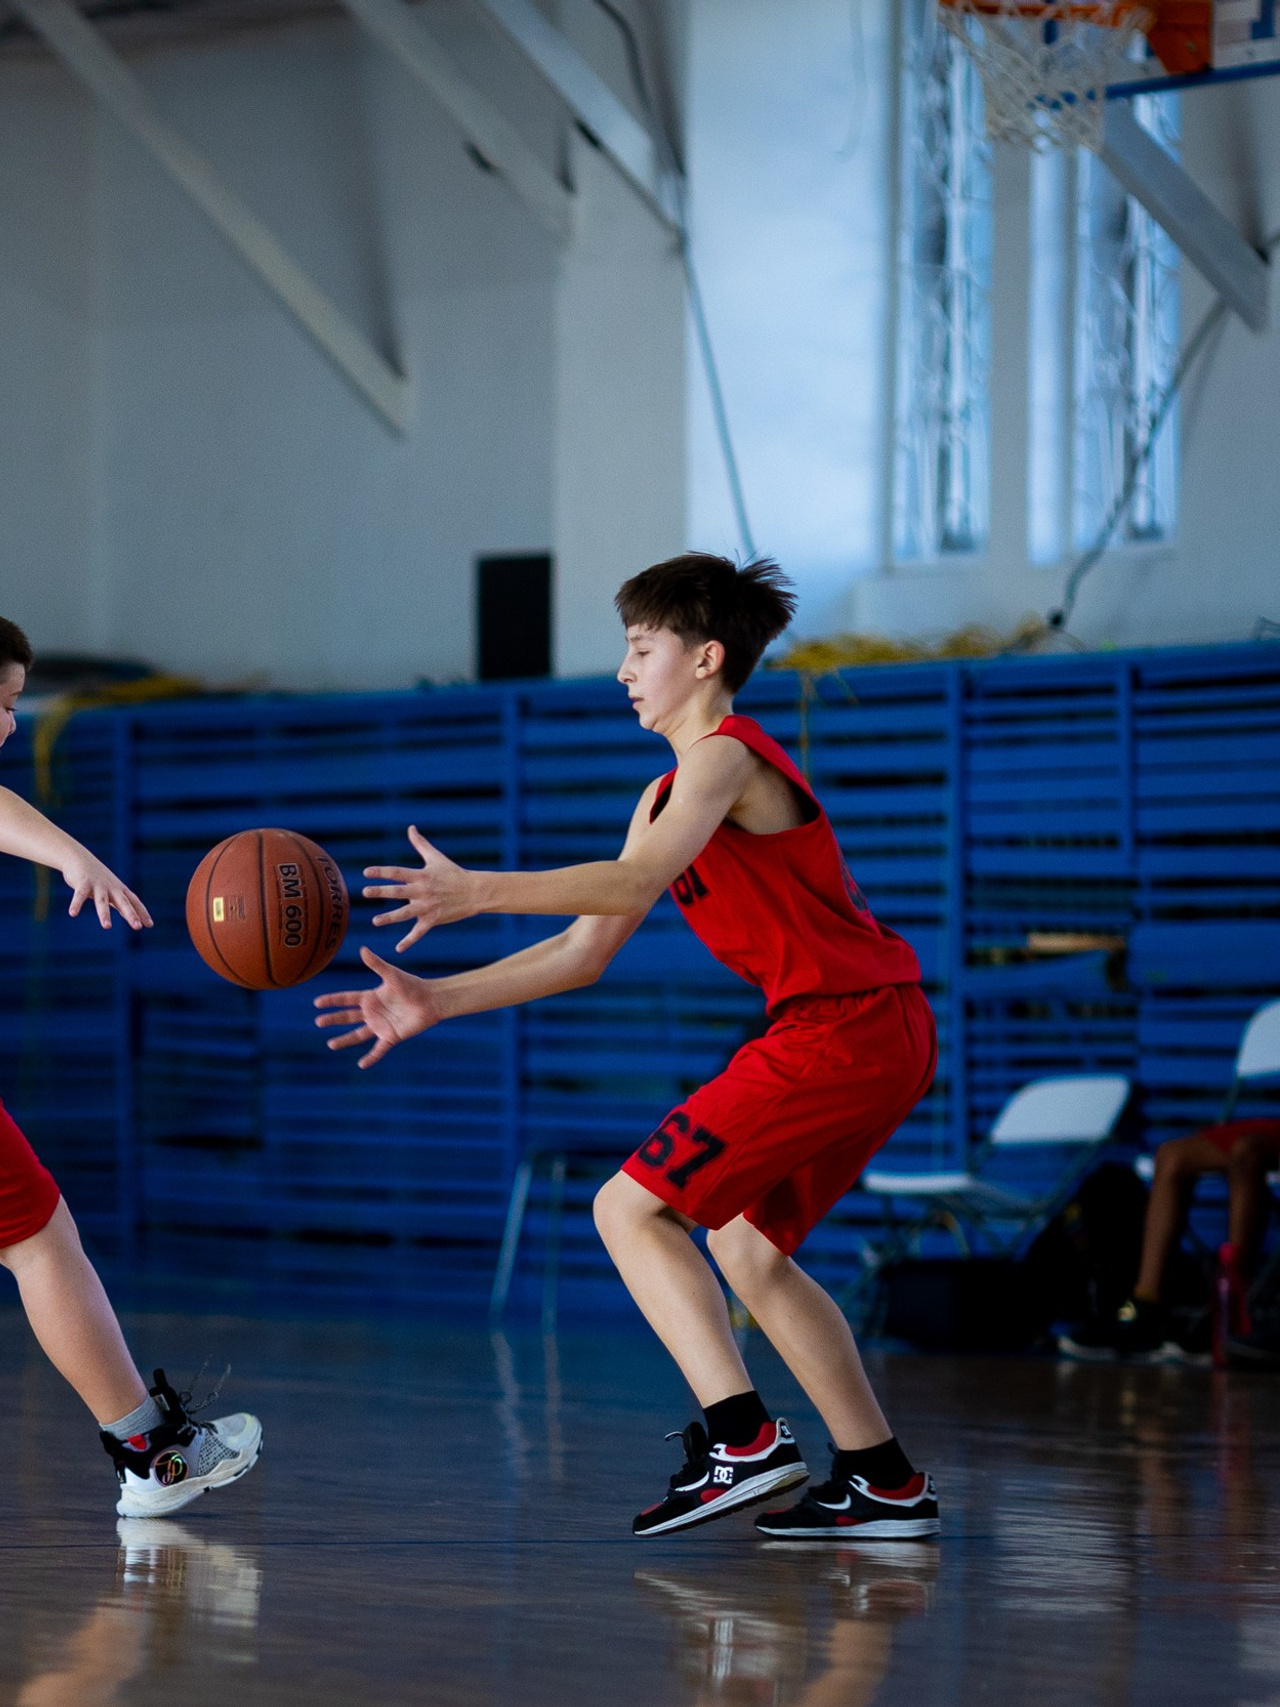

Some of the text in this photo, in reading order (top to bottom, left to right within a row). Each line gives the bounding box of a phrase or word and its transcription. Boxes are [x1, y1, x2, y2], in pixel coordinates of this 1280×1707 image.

[277, 862, 305, 948] BM 600
[317, 856, 343, 950] TORRES
[638, 1109, 726, 1191] 67
[713, 1465, 734, 1485] DC
